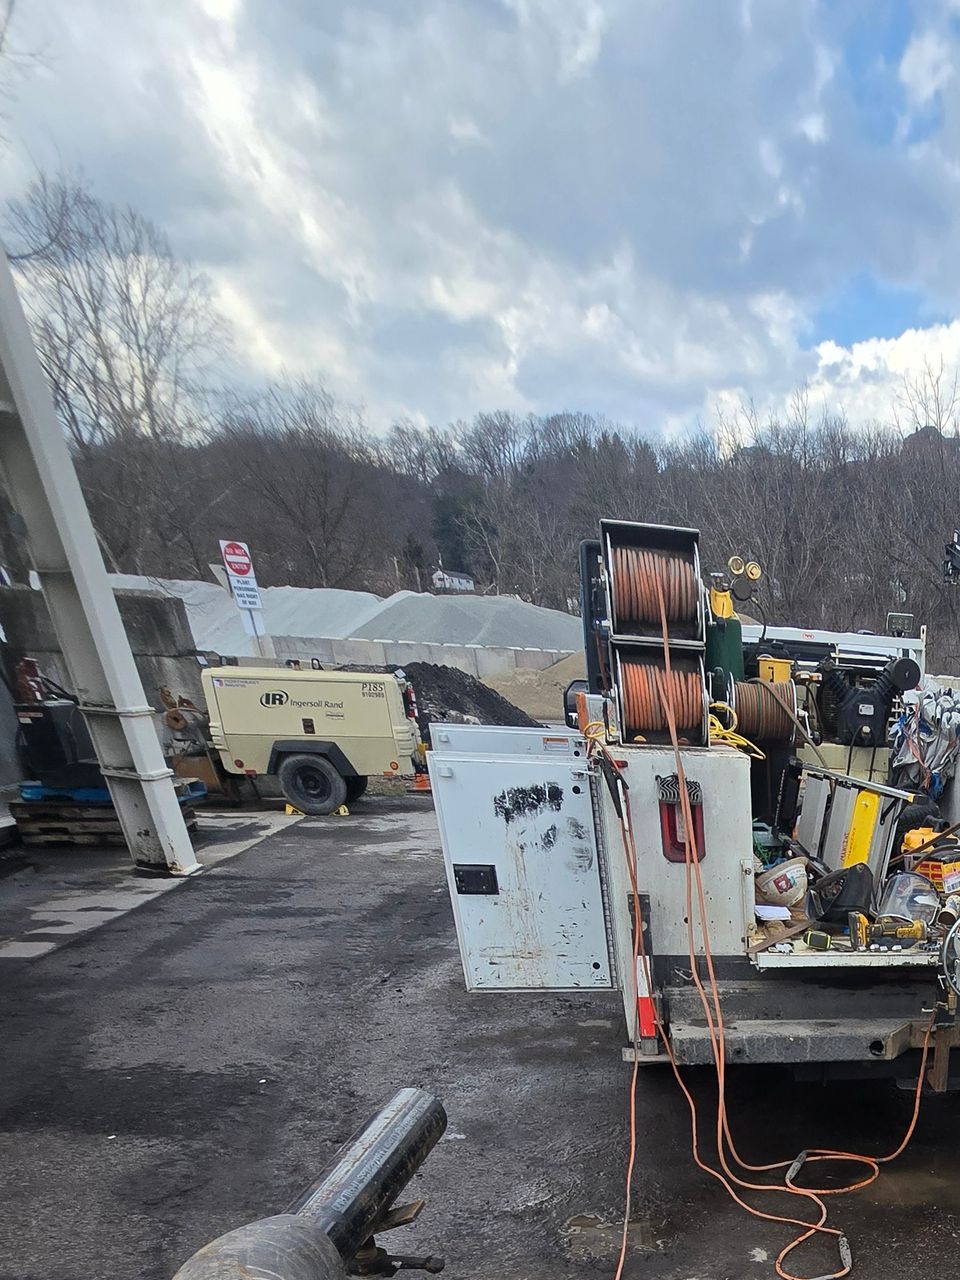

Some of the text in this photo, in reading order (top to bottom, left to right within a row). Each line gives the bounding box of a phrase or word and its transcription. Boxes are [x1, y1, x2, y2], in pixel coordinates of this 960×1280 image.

[361, 682, 384, 692] P185
[290, 699, 344, 709] Ingersoll Rand
